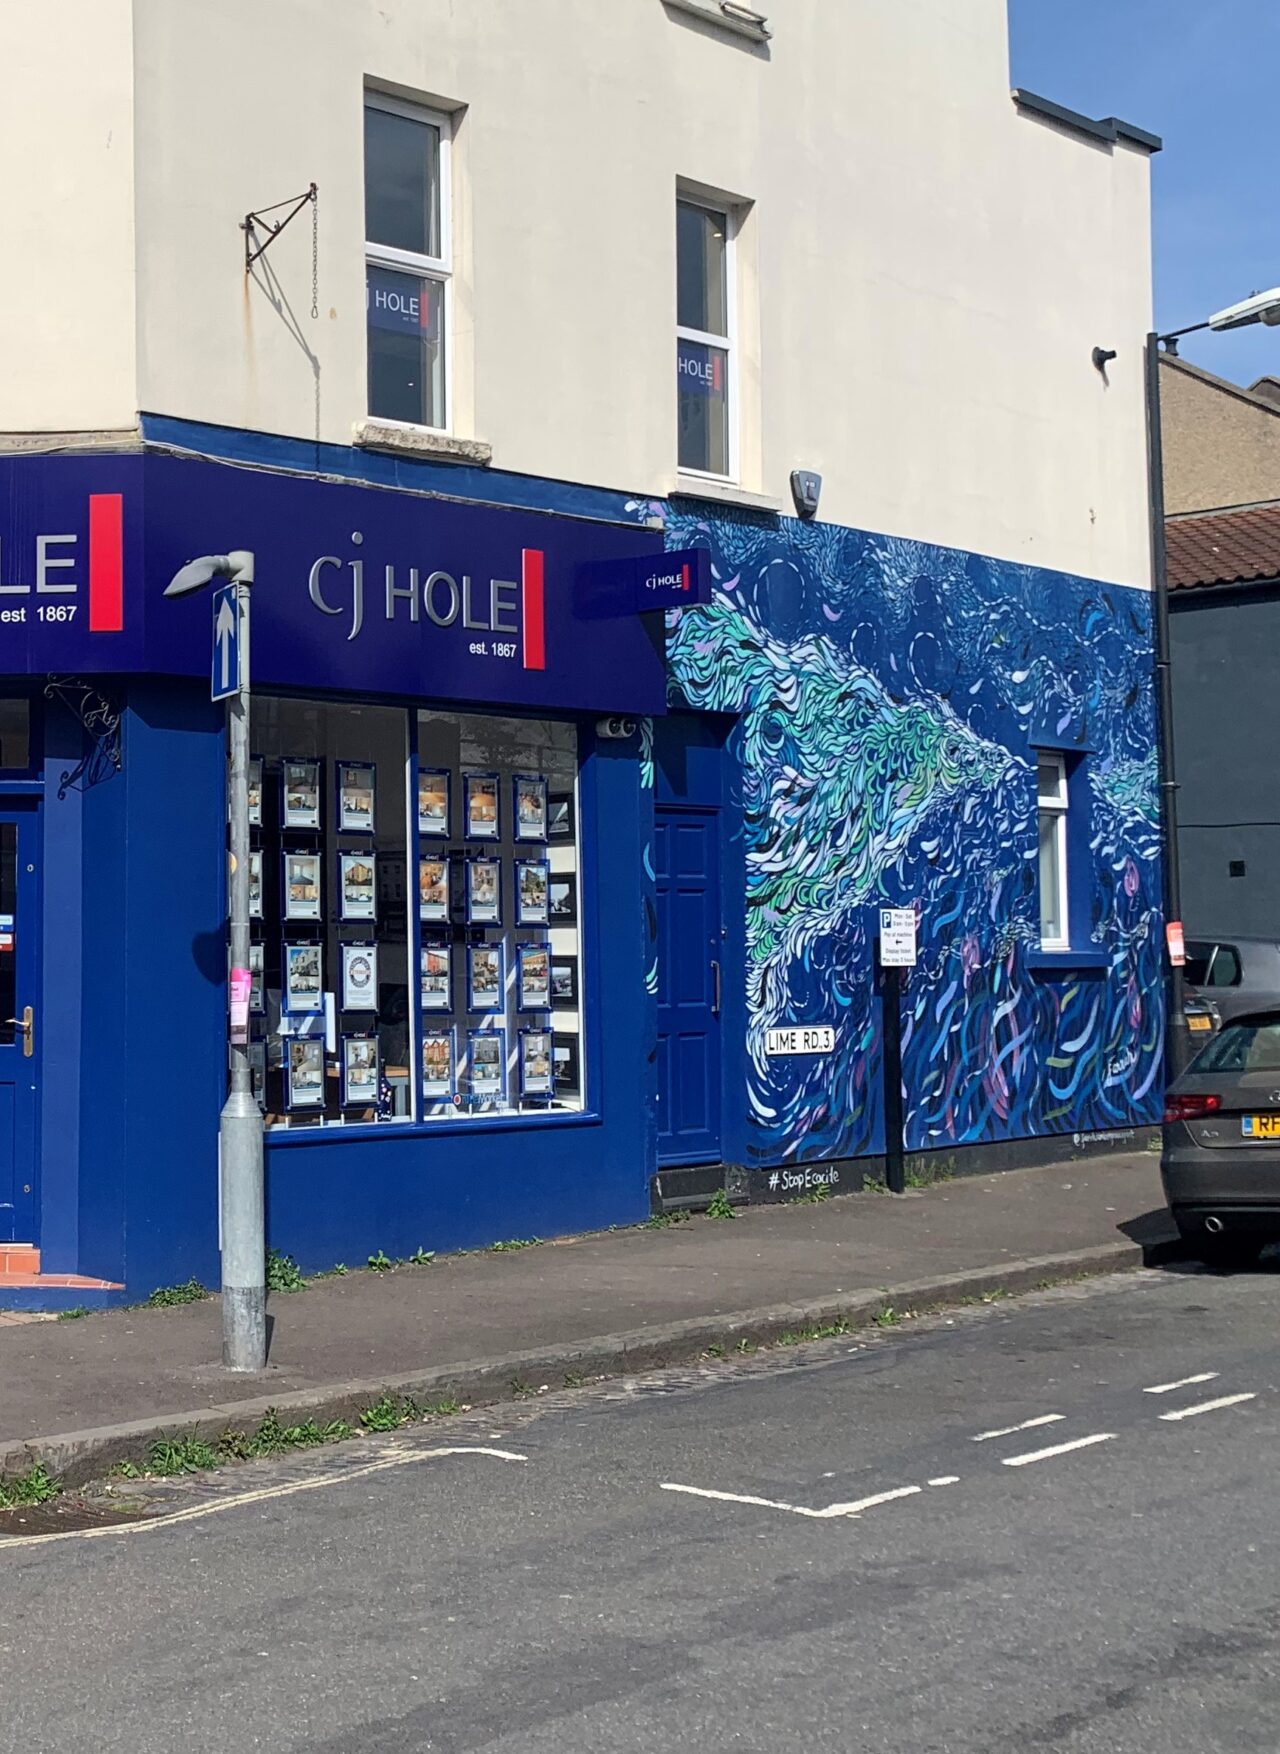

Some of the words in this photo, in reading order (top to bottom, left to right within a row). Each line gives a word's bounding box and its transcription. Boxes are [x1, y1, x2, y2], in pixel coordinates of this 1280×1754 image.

[376, 290, 419, 316] HOLE
[678, 357, 713, 380] HOLE
[308, 531, 364, 641] cj
[385, 565, 518, 633] HOLE
[645, 573, 656, 590] cj
[658, 573, 682, 586] HOLE
[0, 608, 26, 622] est
[36, 606, 78, 622] 1867
[469, 641, 489, 656] est.
[491, 642, 517, 658] 1867
[768, 1032, 796, 1051] LIME
